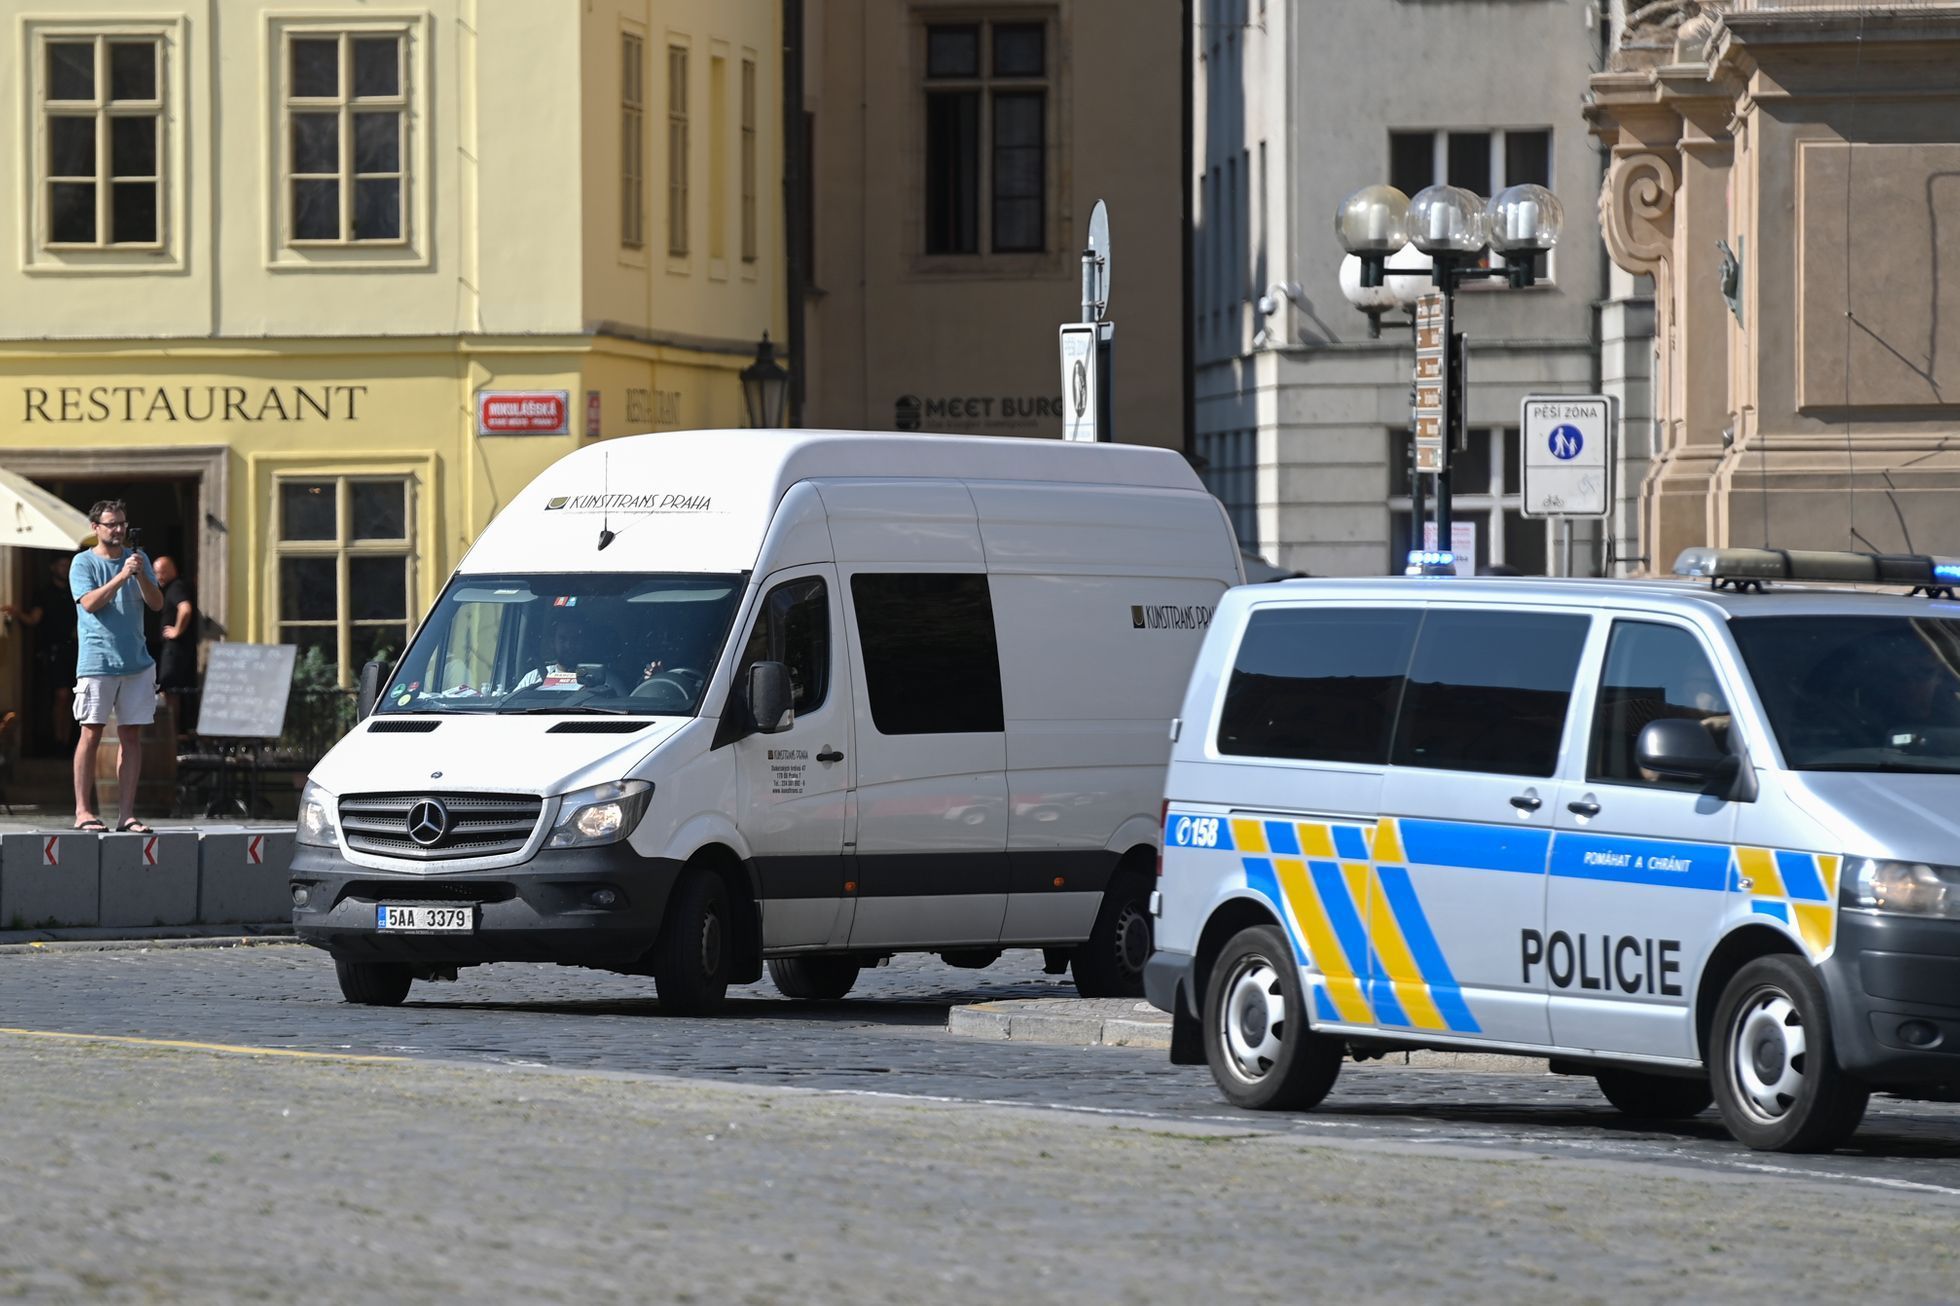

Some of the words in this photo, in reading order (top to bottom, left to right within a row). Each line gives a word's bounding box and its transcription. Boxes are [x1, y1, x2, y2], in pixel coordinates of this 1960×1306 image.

[21, 386, 368, 422] RESTAURANT
[926, 397, 995, 417] MEET
[1564, 403, 1598, 418] ZÓNA
[570, 494, 659, 509] KUNSTTRANS
[660, 494, 712, 510] PRAHA
[1146, 605, 1195, 629] KUNSTTRANS
[1192, 818, 1219, 847] 158
[1583, 850, 1632, 867] POMÁHAT
[1634, 856, 1643, 868] A
[1647, 855, 1693, 872] CHRÁNIT
[389, 909, 415, 927] 5AA
[426, 910, 465, 927] 3379
[1521, 928, 1683, 996] POLICIE
